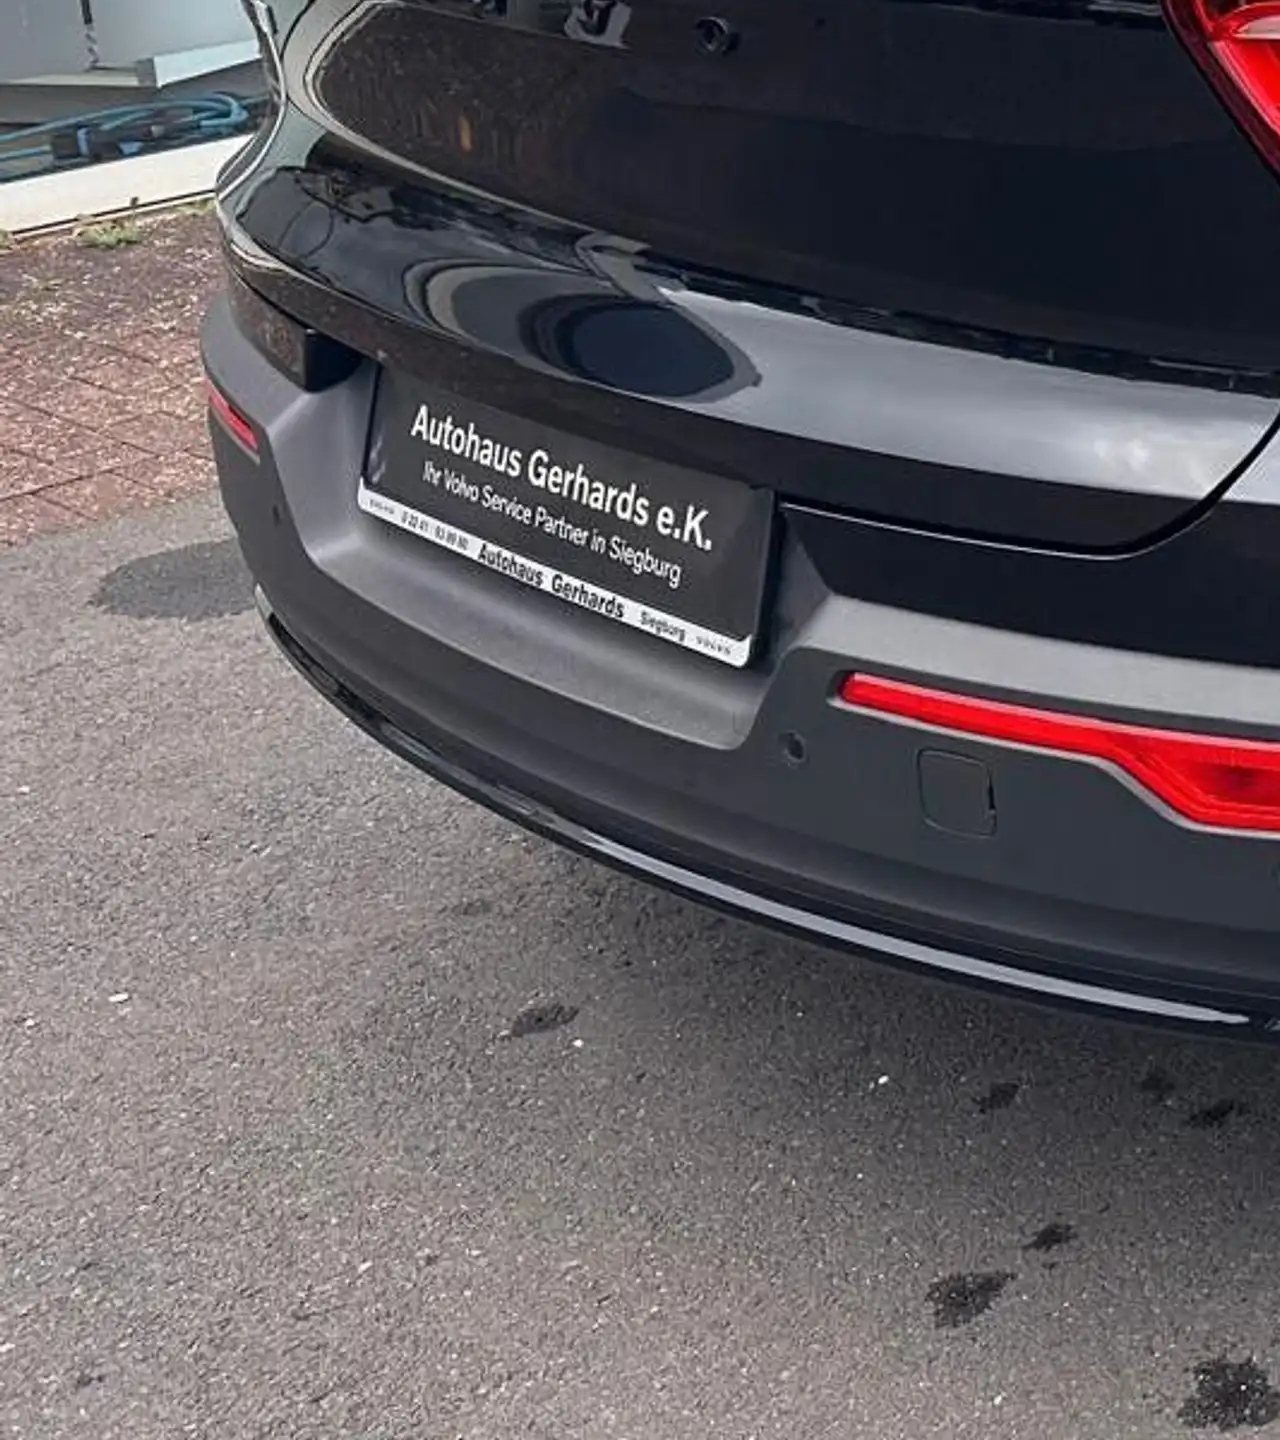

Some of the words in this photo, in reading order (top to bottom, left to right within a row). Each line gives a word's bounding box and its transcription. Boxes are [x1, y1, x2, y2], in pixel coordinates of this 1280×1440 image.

[410, 404, 522, 477] Autohaus
[527, 449, 650, 527] Gerhards
[656, 505, 713, 551] e.K.
[422, 461, 442, 486] Ihr
[444, 469, 479, 502] Volvo
[481, 485, 532, 524] Service
[534, 506, 590, 547] Partner
[590, 529, 607, 554] in
[609, 536, 682, 589] Siegburg
[478, 543, 543, 587] Autohaus
[552, 574, 625, 618] Gerhards
